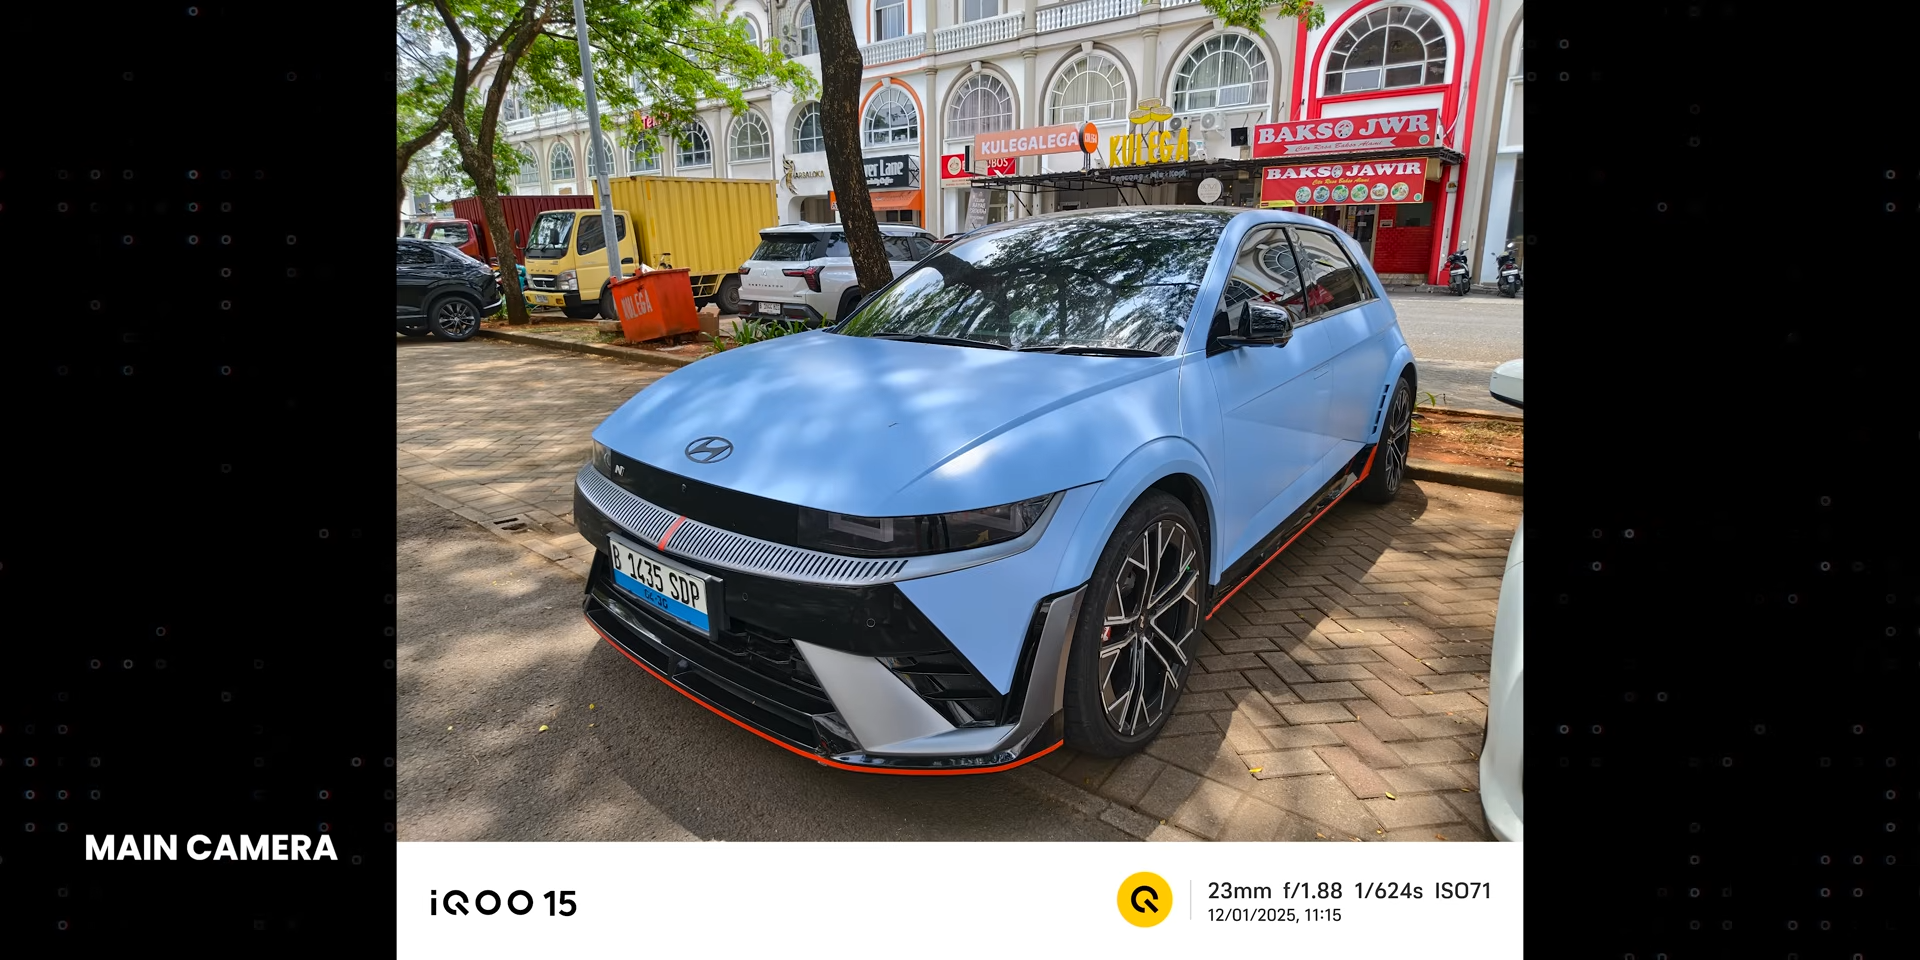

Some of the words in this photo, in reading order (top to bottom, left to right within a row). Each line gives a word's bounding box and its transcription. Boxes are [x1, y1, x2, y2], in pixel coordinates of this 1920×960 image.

[1257, 119, 1354, 144] BAKSO
[1359, 114, 1430, 136] JWR
[981, 130, 1079, 155] KULEGALEGA
[1109, 127, 1189, 168] KULEGA
[1295, 144, 1310, 152] Cita
[880, 159, 904, 177] Lane
[1168, 169, 1186, 178] Kopi
[1266, 164, 1343, 180] BAKSO
[1345, 161, 1422, 177] JAWIR
[621, 289, 653, 321] KULEGA
[612, 543, 622, 570] B
[628, 552, 664, 593] 1435
[669, 572, 700, 608] SDP
